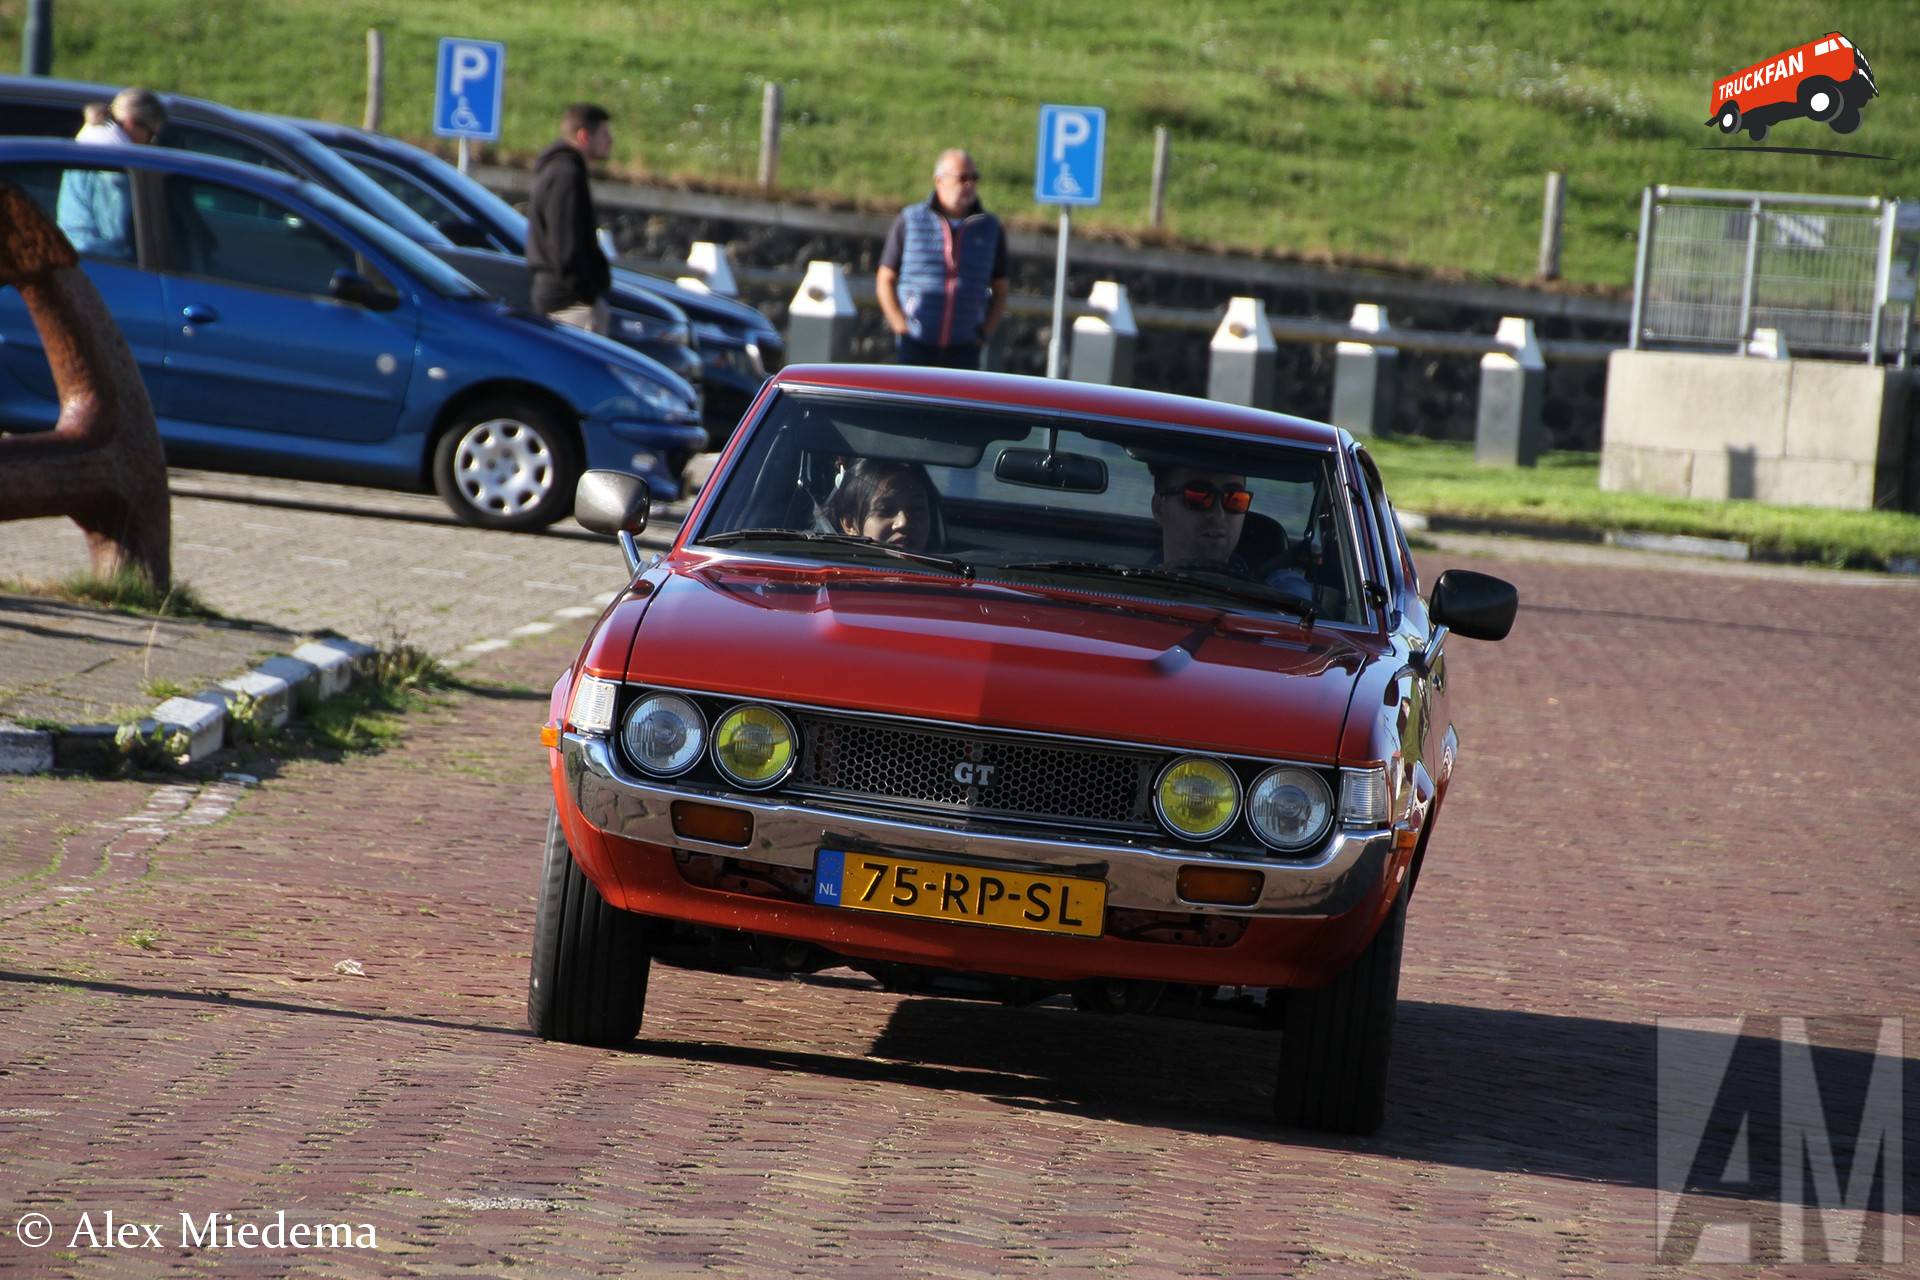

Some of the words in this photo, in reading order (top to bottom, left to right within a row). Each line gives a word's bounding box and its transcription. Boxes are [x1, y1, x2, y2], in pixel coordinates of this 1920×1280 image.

[450, 44, 488, 95] P
[1053, 111, 1091, 162] P
[954, 761, 995, 786] GT
[819, 882, 838, 897] NL
[860, 862, 1083, 927] 75-RP-SL
